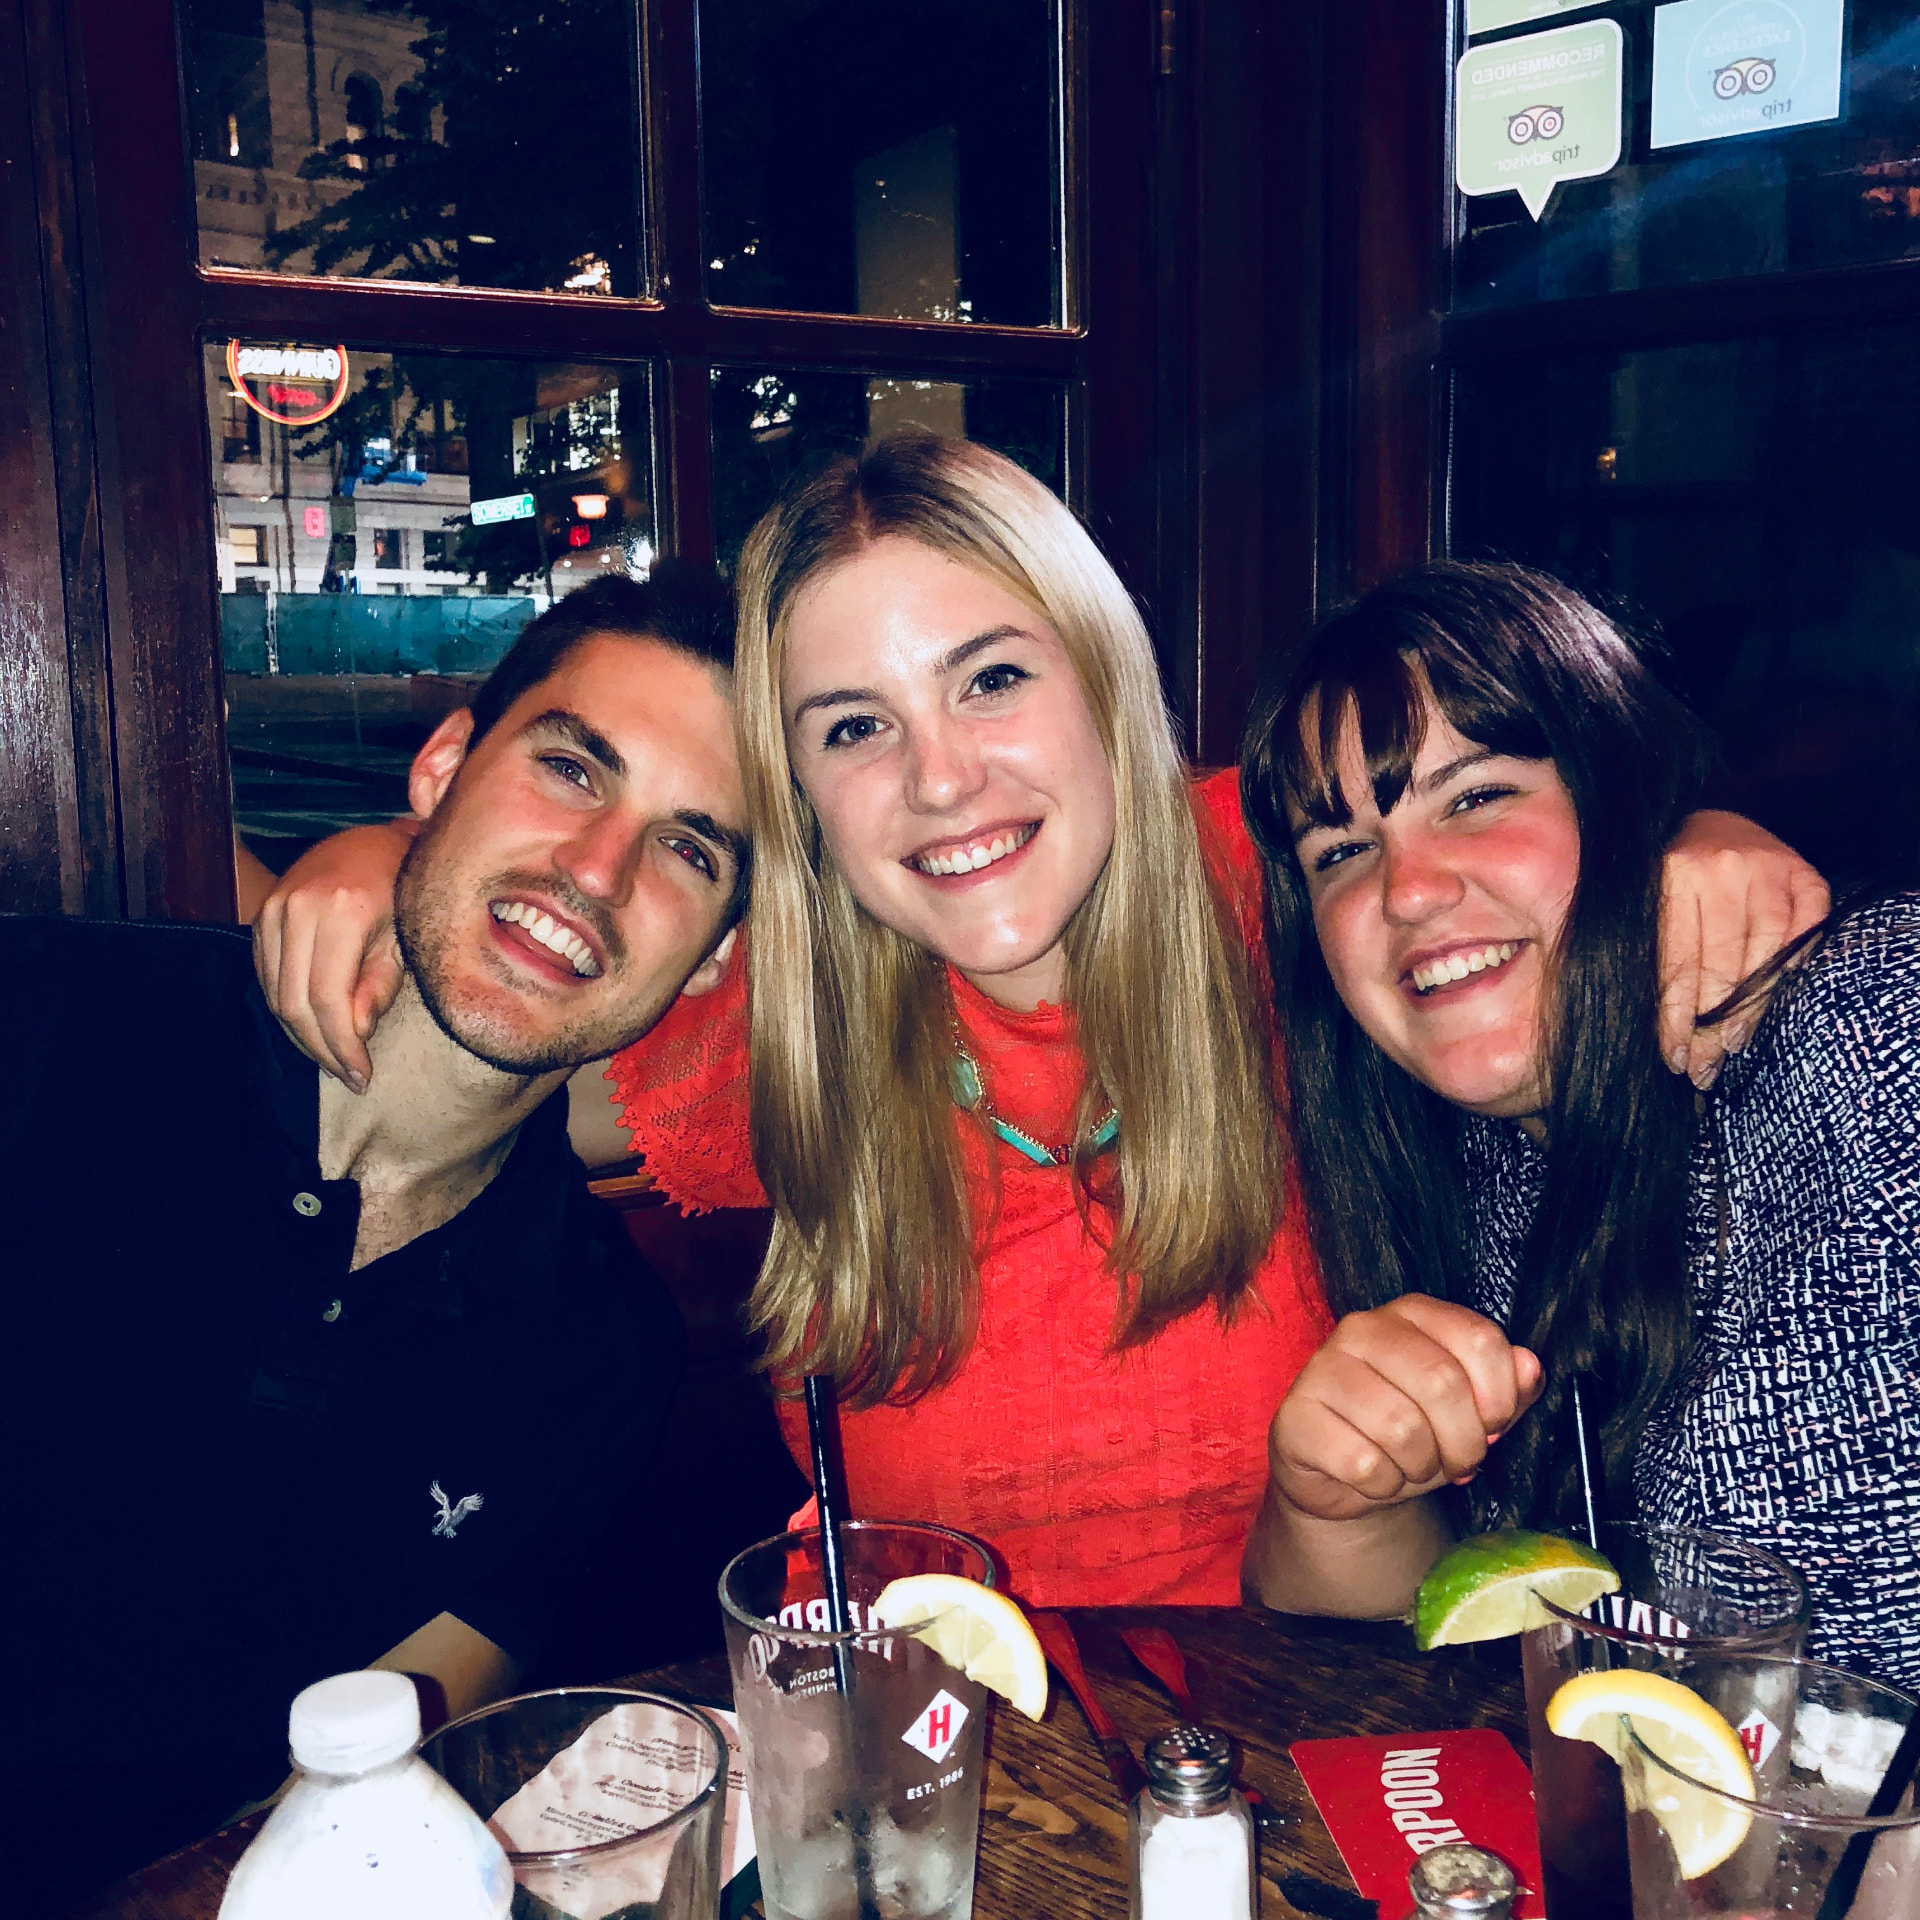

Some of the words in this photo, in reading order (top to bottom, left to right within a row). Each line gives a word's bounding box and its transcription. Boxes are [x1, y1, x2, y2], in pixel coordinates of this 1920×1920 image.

[928, 1703, 951, 1749] H
[1741, 1724, 1764, 1767] H
[906, 1782, 936, 1800] EST.
[939, 1766, 964, 1789] 1986
[1380, 1748, 1473, 1856] RPOON
